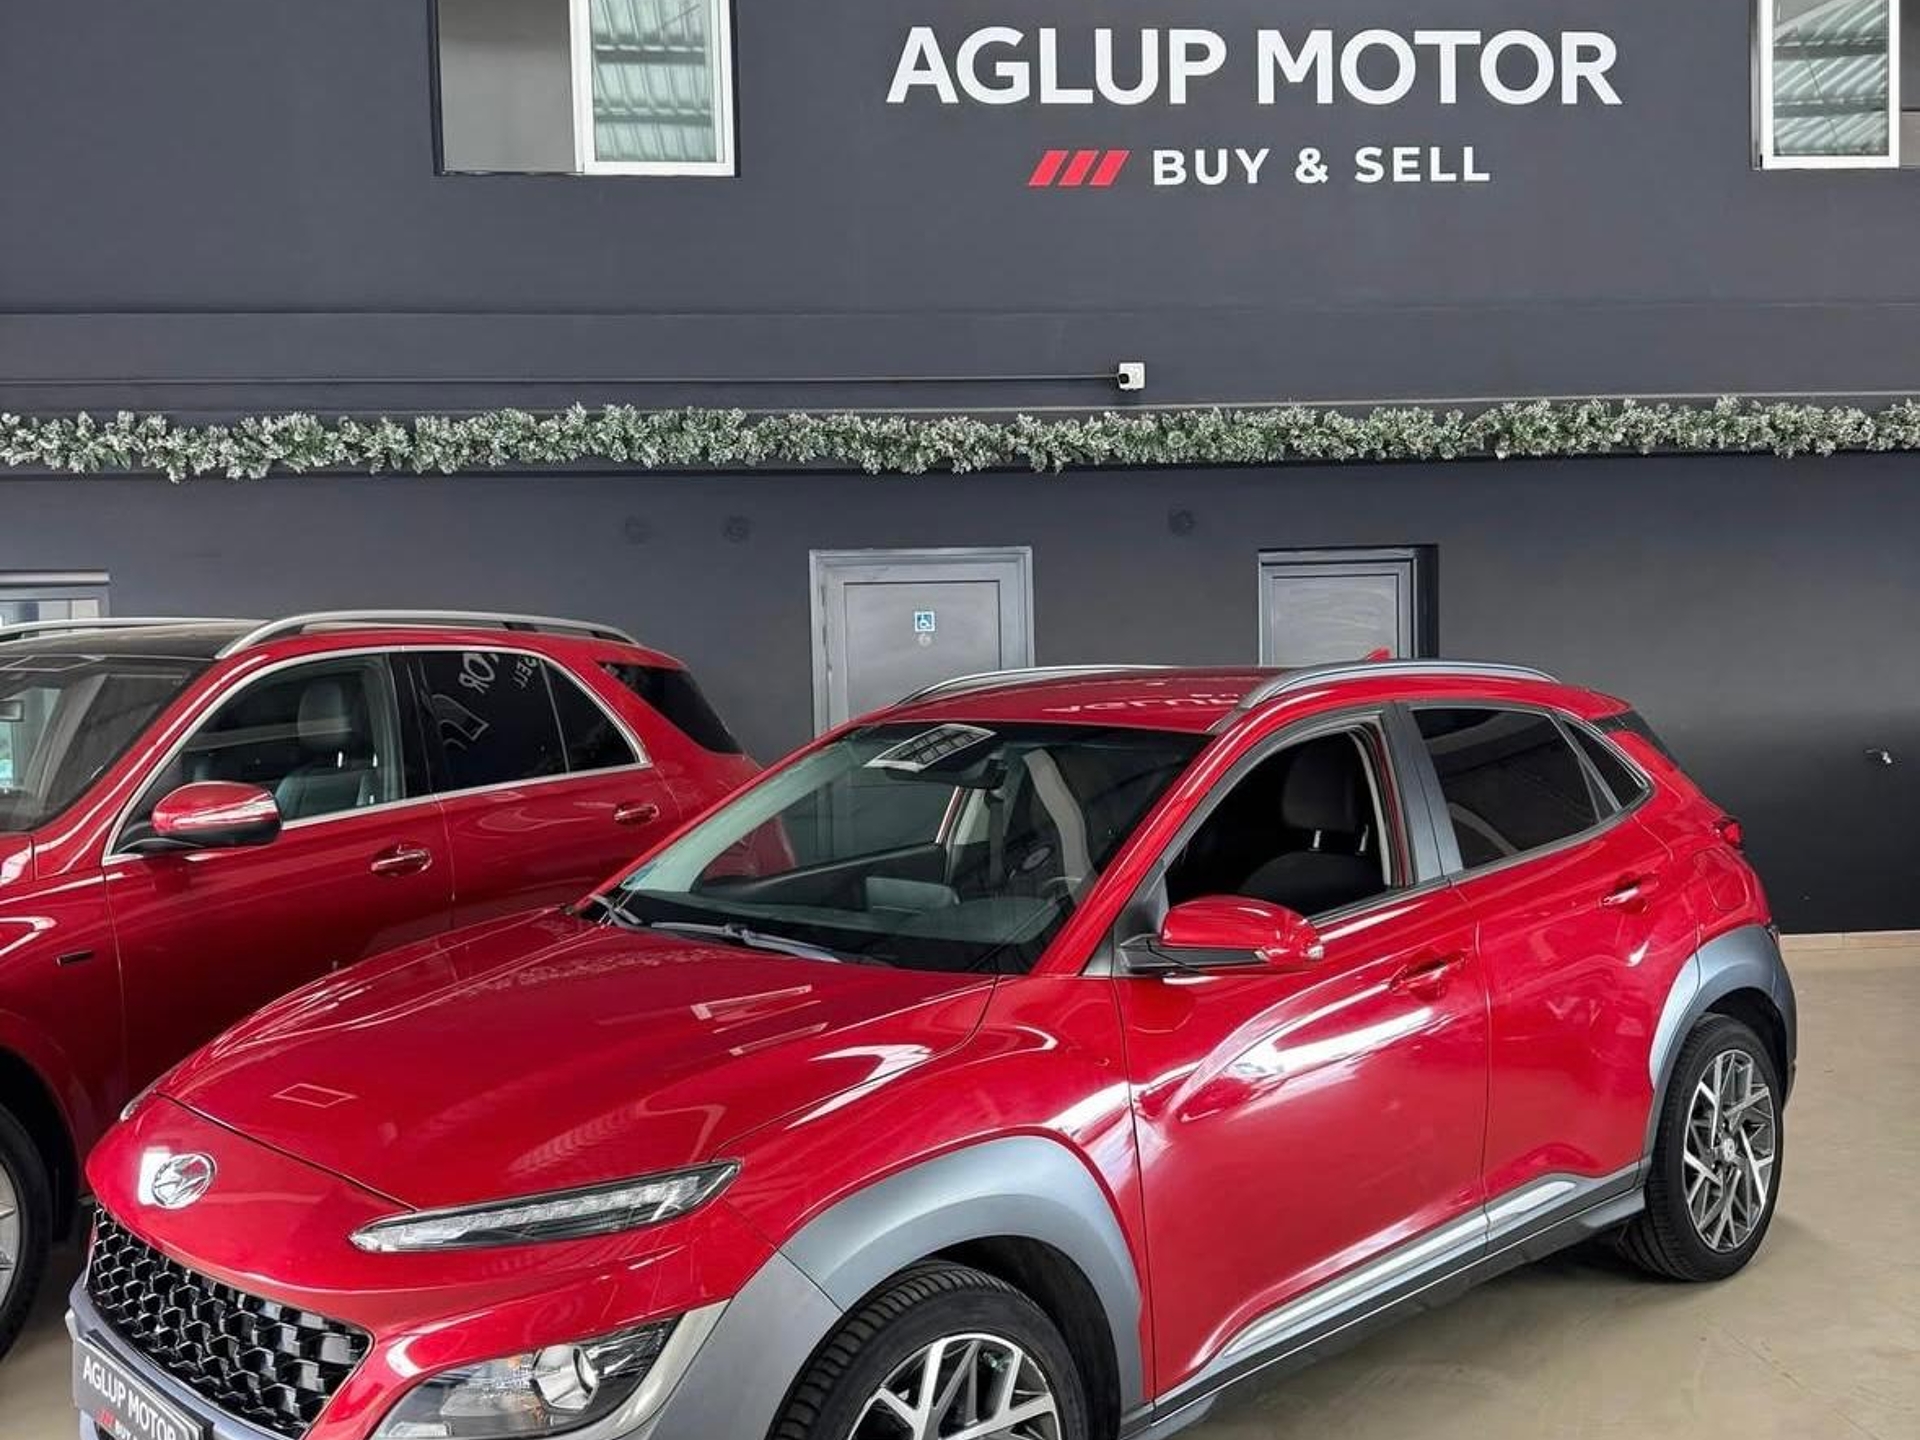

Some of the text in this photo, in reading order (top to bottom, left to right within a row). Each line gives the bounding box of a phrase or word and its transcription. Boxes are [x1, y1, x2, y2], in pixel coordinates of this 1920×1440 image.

[885, 26, 1623, 106] AGLUP MOTOR
[1152, 146, 1490, 186] BUY & SELL
[82, 1355, 126, 1408] AGLUP
